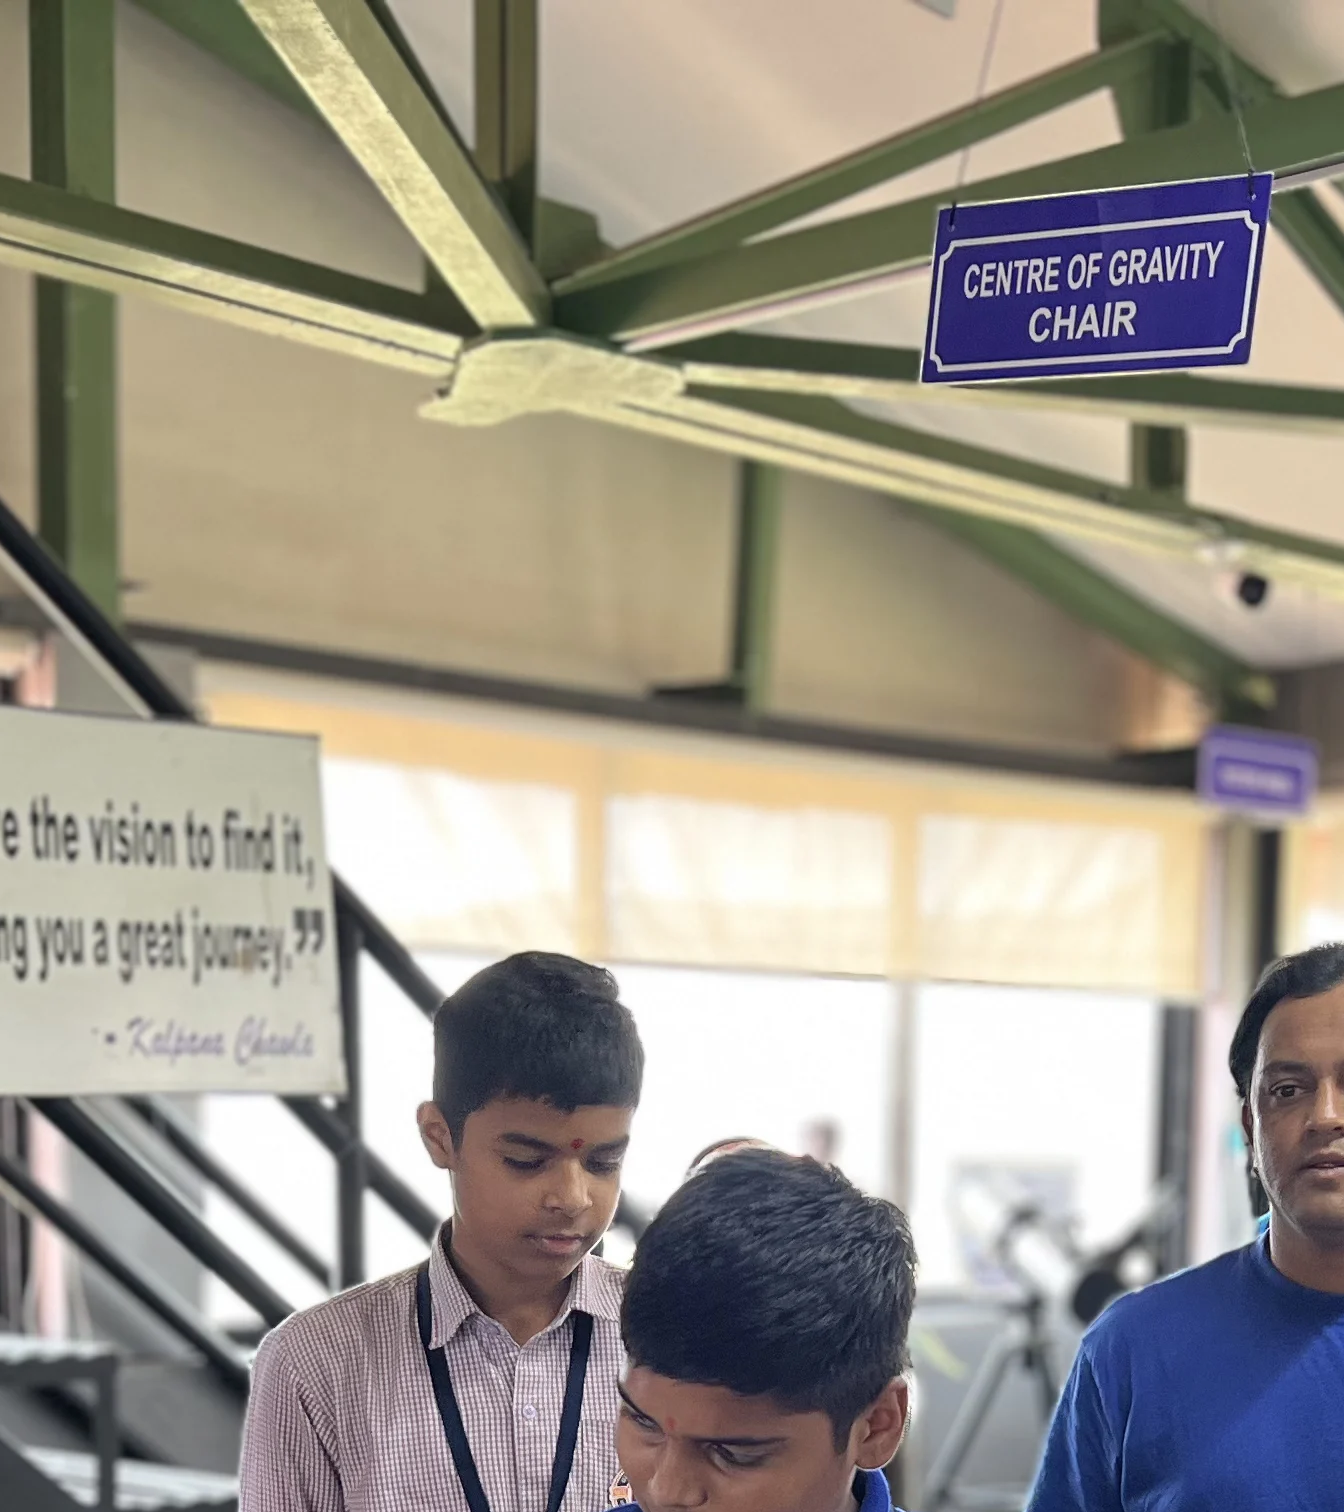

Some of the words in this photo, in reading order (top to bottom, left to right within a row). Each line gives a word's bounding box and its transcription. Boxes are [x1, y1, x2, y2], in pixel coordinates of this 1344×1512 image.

[963, 256, 1060, 300] CENTRE
[1067, 252, 1103, 290] OF
[1108, 241, 1225, 287] GRAVITY
[1028, 301, 1137, 343] CHAIR
[30, 796, 80, 862] the
[90, 803, 177, 869] vision
[185, 811, 214, 872] to
[222, 809, 275, 875] find
[38, 924, 83, 983] you
[92, 927, 110, 964] a
[118, 911, 185, 978] great
